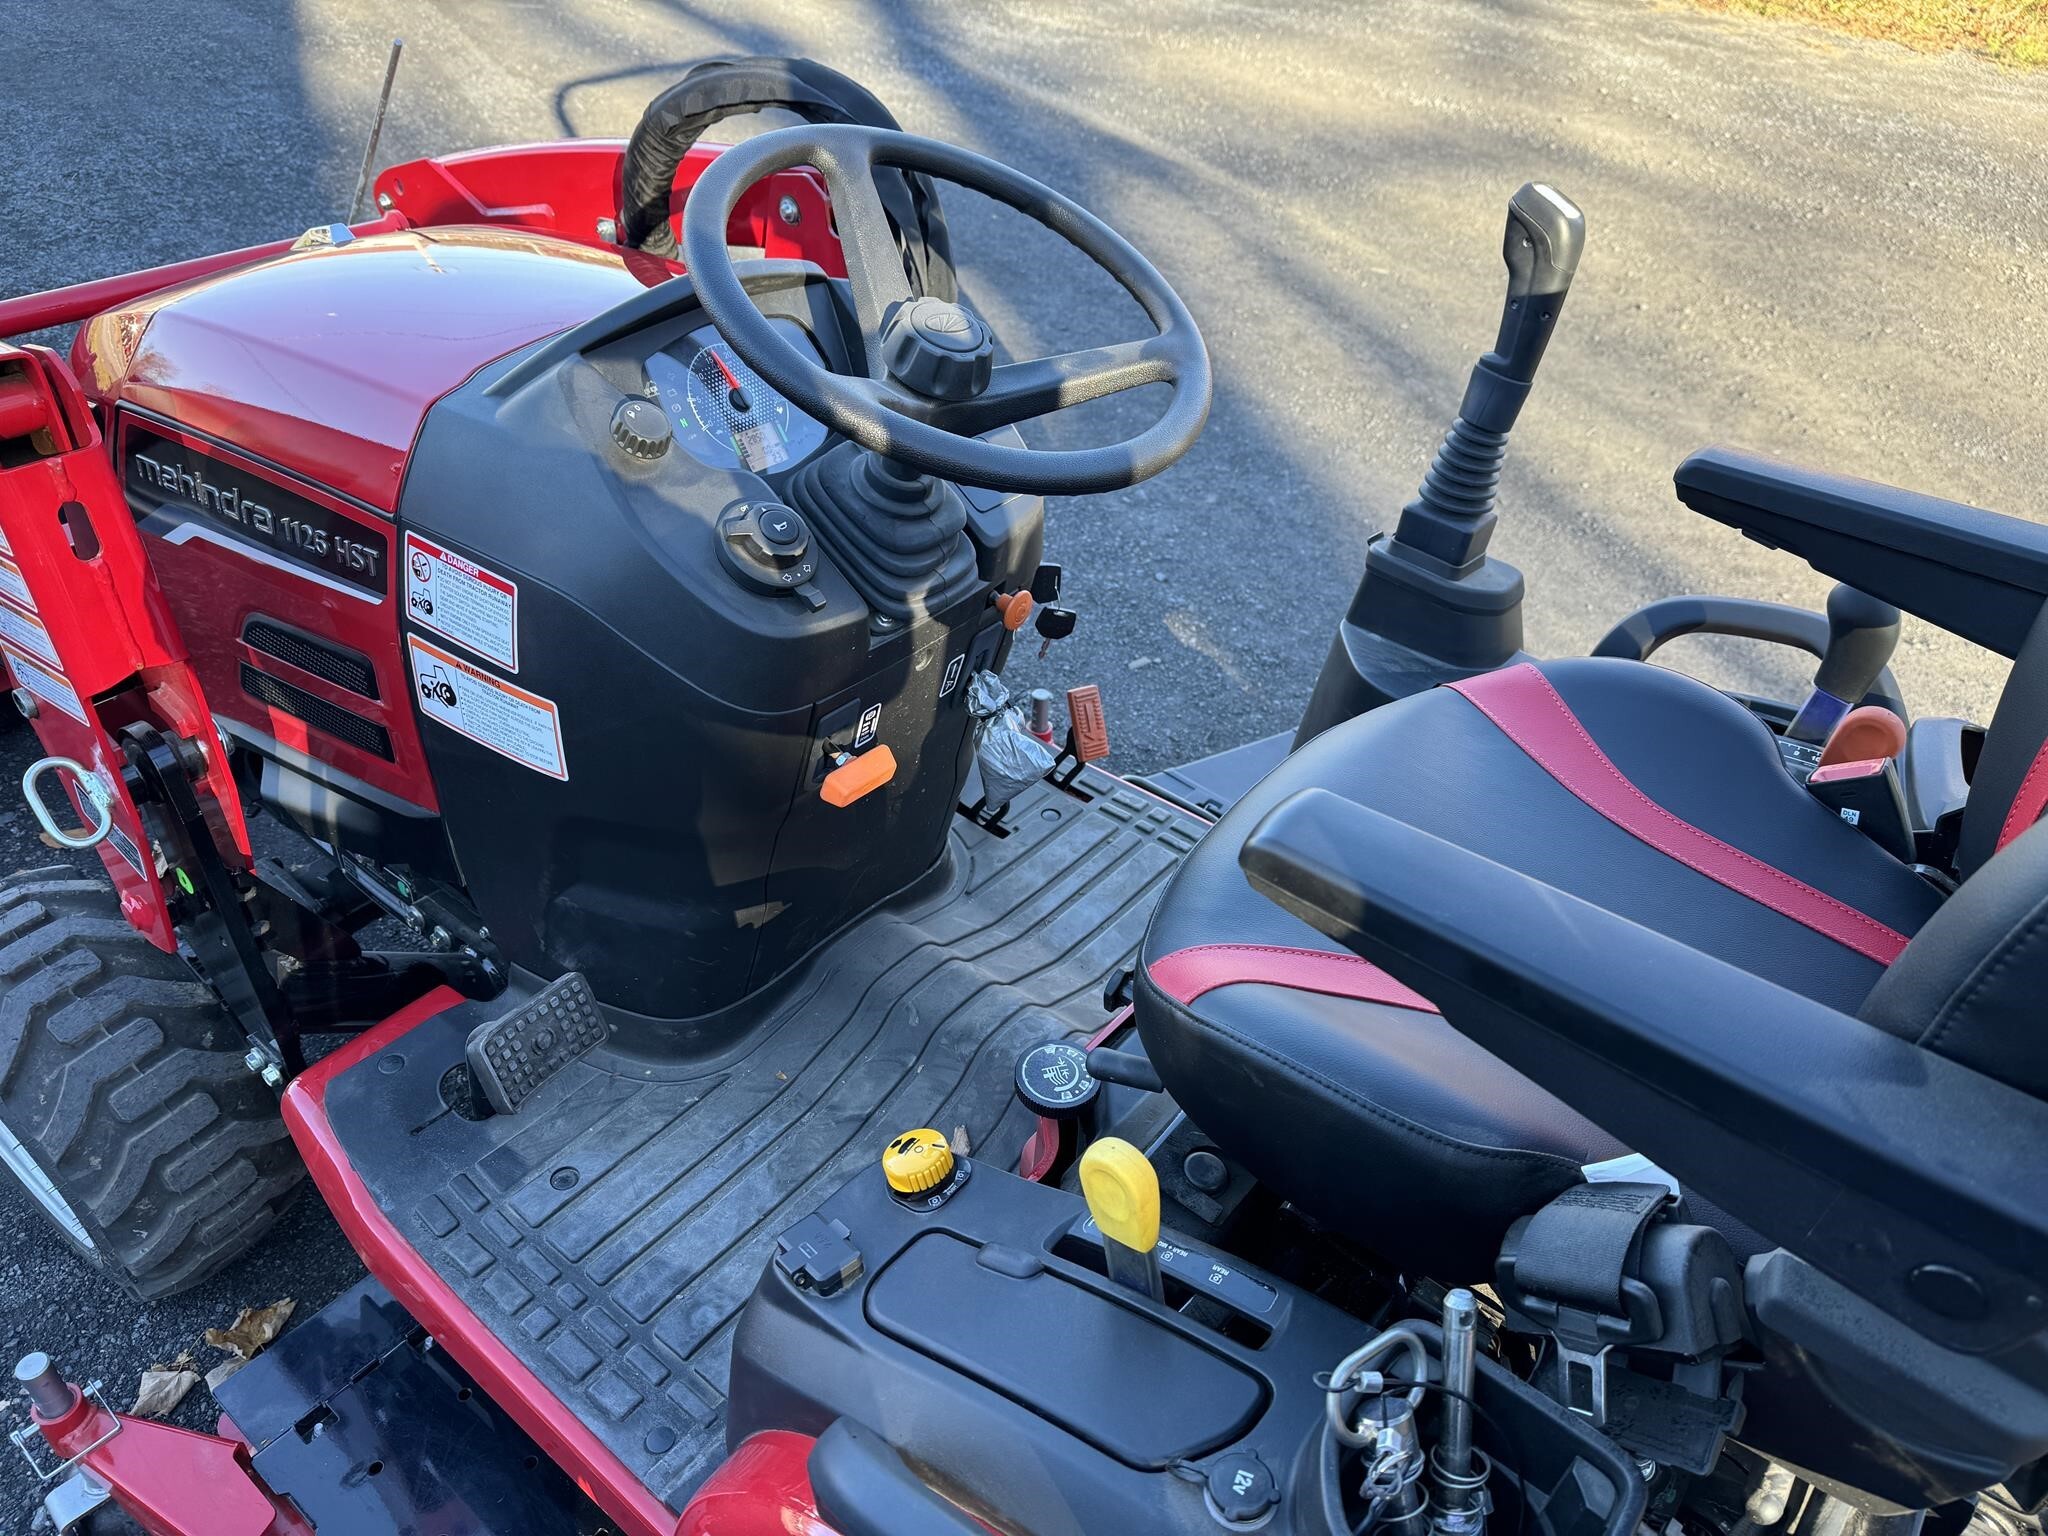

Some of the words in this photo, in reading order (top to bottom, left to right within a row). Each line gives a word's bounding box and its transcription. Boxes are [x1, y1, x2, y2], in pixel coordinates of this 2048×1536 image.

[135, 453, 277, 536] mahindra
[280, 516, 329, 558] 1126
[334, 536, 379, 577] HST
[447, 554, 480, 578] DANGER
[463, 666, 501, 689] WARNING
[1172, 1246, 1189, 1258] REAR
[1211, 1264, 1230, 1276] REAR
